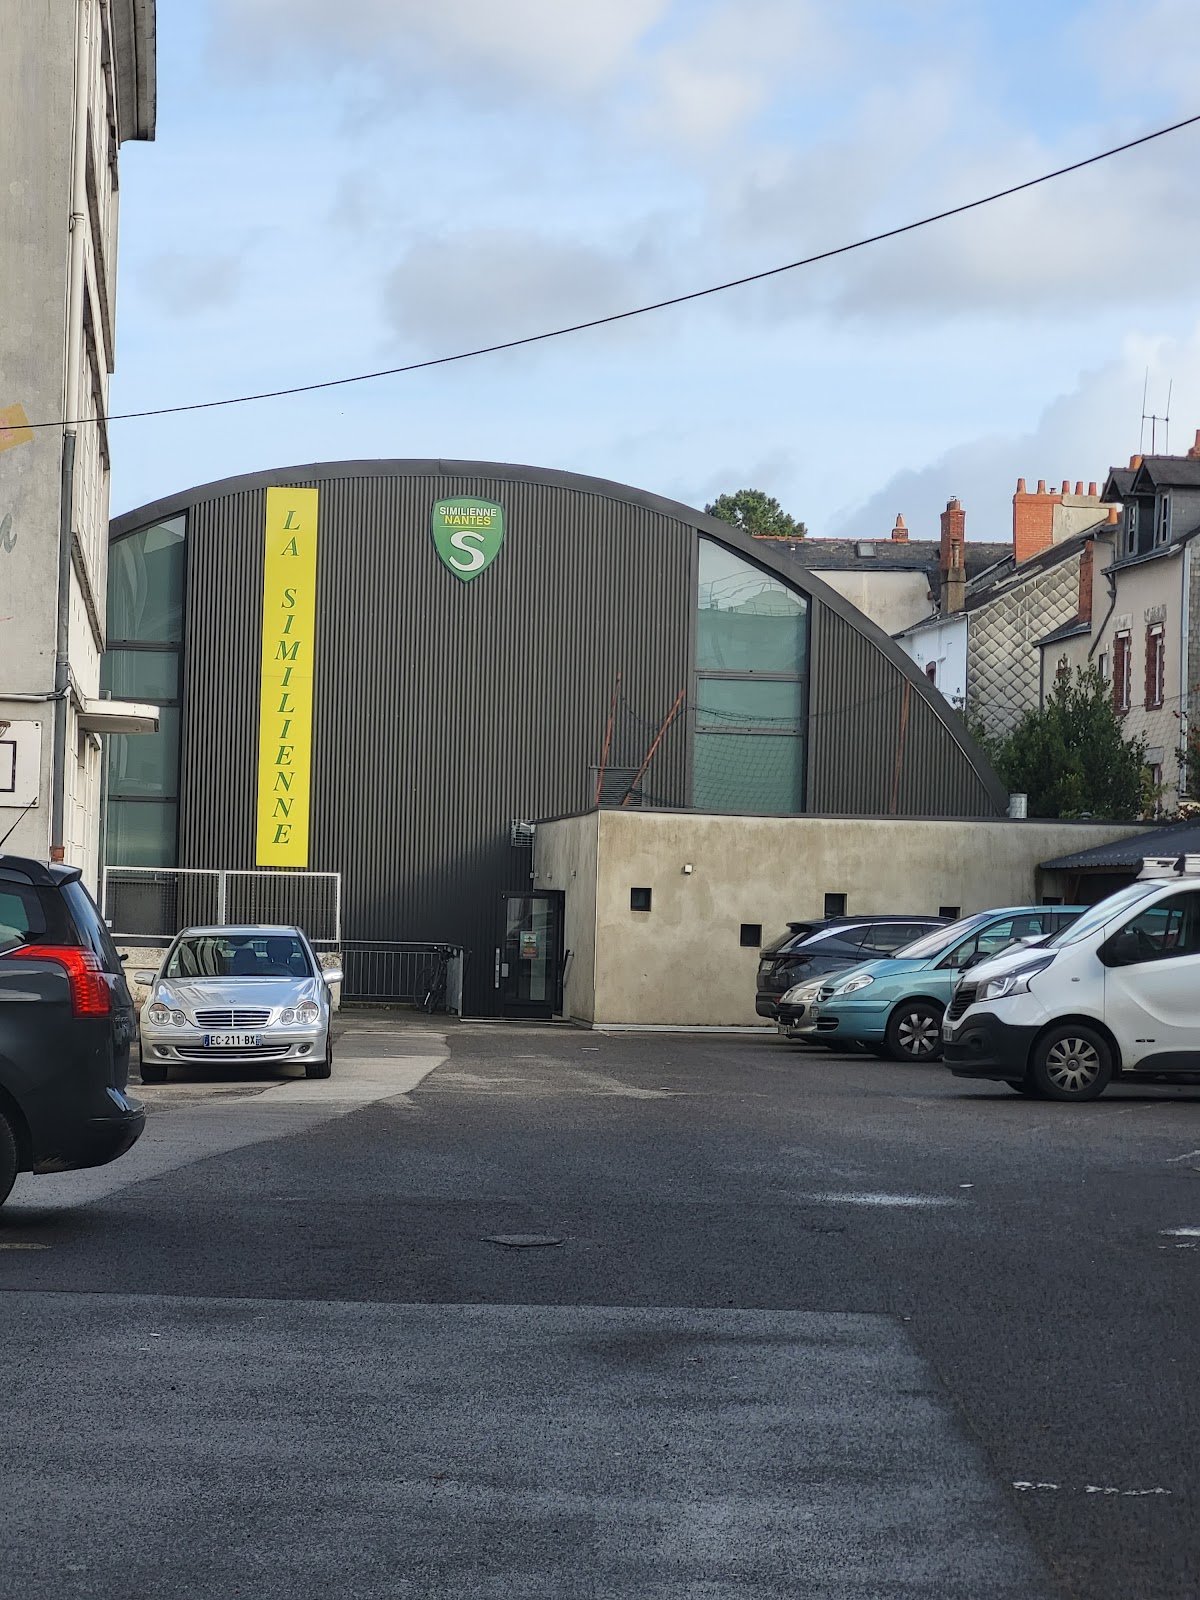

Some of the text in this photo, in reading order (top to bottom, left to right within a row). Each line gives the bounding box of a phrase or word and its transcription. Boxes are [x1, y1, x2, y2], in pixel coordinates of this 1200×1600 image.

[439, 507, 497, 517] SIMILIENNE
[444, 515, 491, 525] NANTES
[449, 530, 485, 571] S
[271, 510, 301, 845] LA SIMILIENNE
